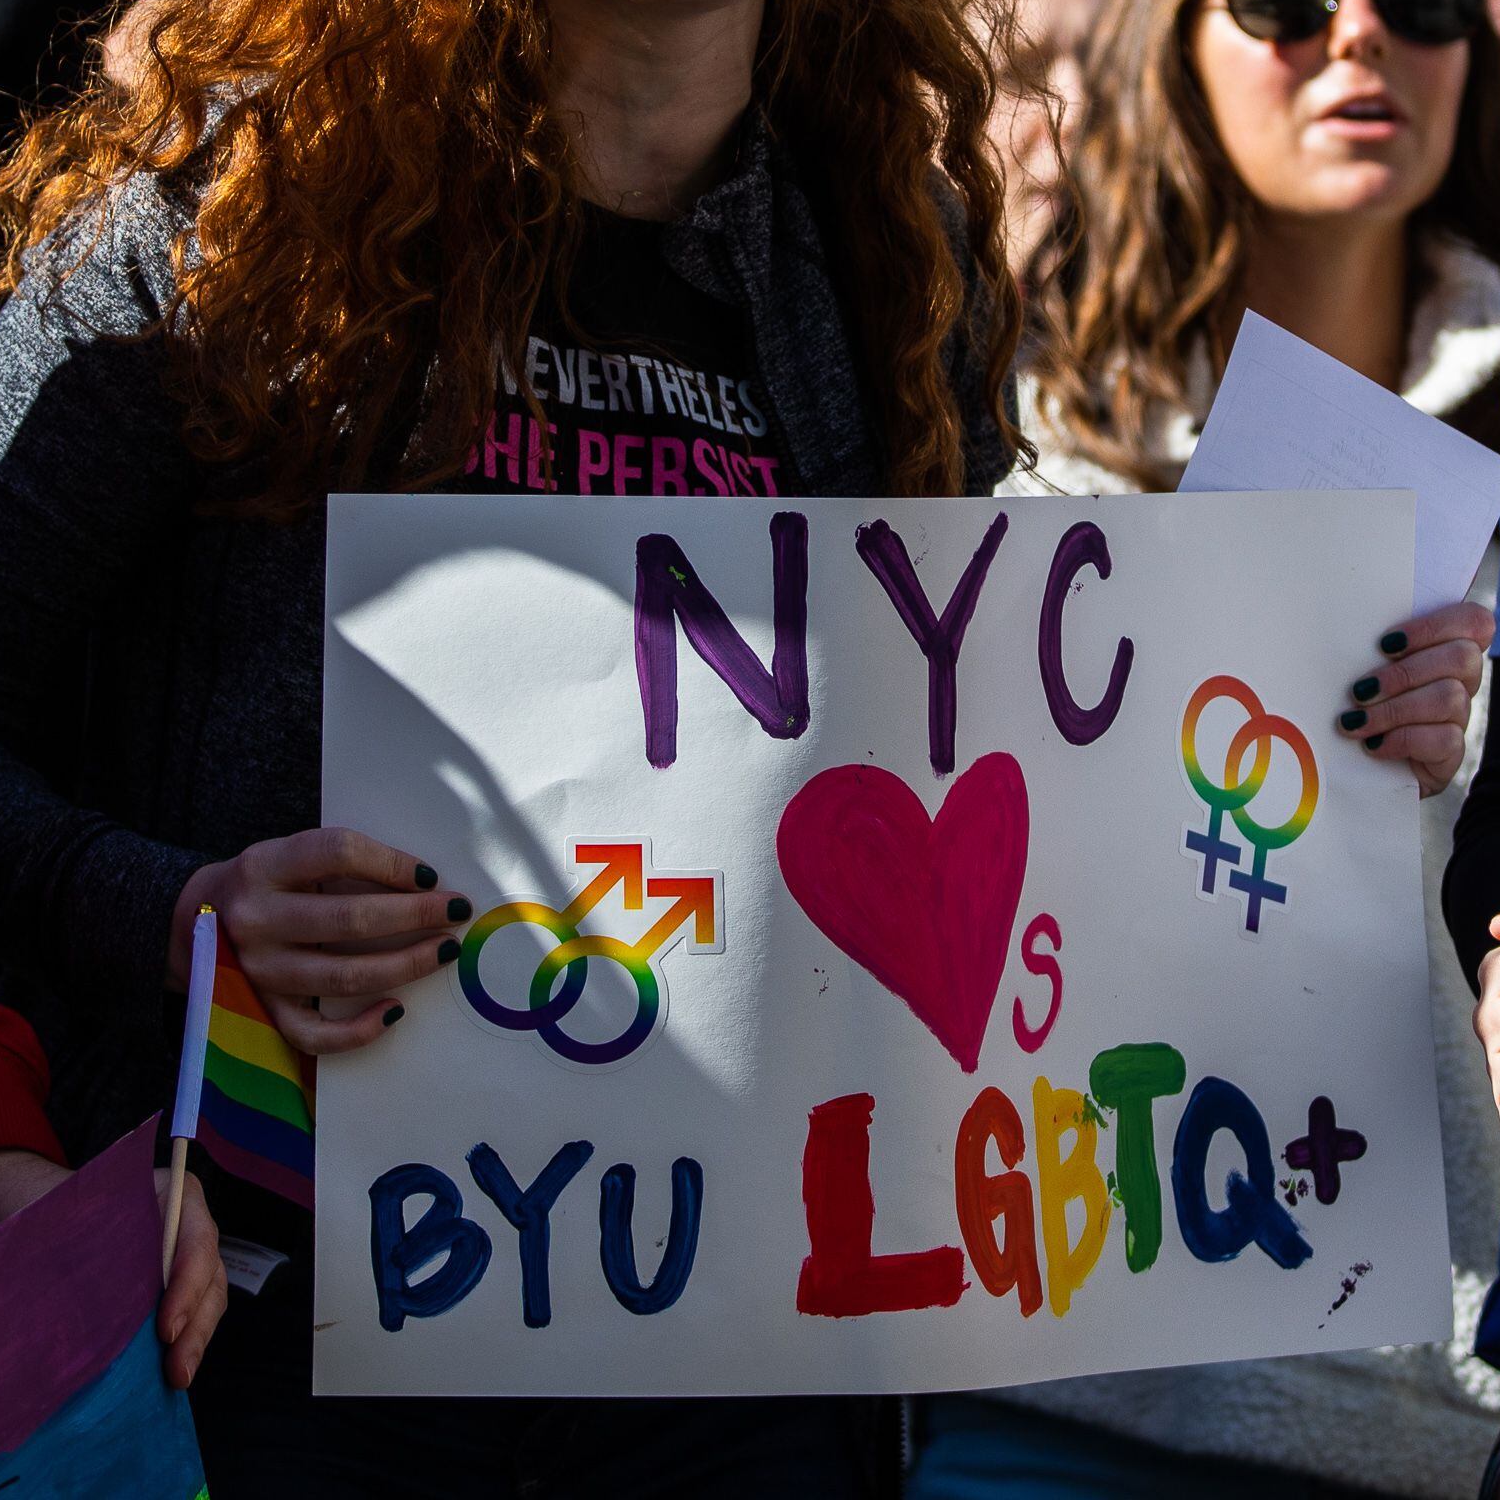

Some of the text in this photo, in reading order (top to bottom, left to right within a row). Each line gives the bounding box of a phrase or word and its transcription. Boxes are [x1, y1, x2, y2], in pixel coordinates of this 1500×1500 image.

[464, 410, 557, 492] HE
[633, 511, 1135, 777] NYC
[368, 1042, 1368, 1333] BYU LGBTQ+
